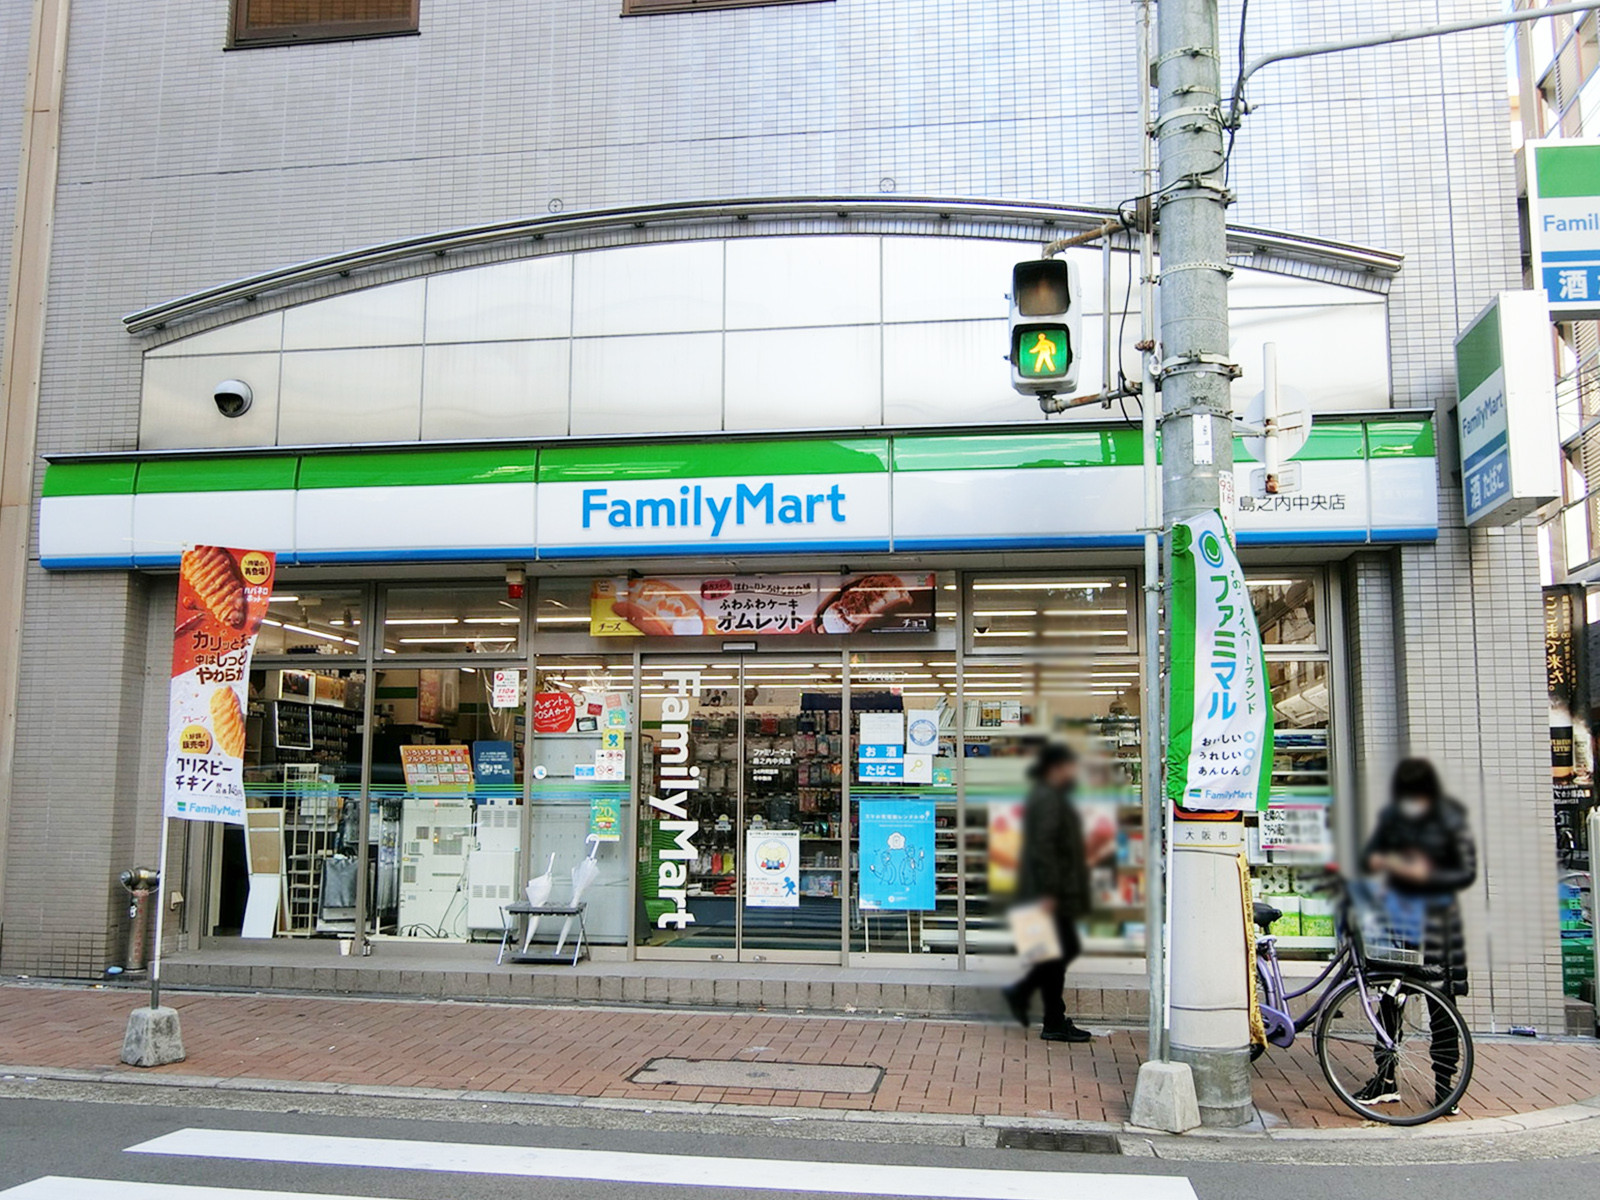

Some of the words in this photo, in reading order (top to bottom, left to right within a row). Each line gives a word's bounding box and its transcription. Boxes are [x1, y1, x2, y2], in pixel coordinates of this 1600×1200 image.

[1559, 270, 1588, 299] 酒
[1462, 390, 1503, 438] FamilyMart
[1470, 473, 1482, 509] 酒
[1483, 463, 1505, 499] たばこ
[582, 483, 845, 537] FamilyMart
[1239, 494, 1346, 512] 島之内中央店
[720, 598, 799, 610] ふわふわケーキ
[599, 622, 621, 631] チーズ
[717, 611, 804, 631] オムレット
[902, 618, 927, 628] チョコ
[1207, 575, 1237, 720] ファミマル
[865, 746, 897, 757] お酒
[177, 758, 233, 776] クリスピー
[865, 764, 896, 776] たばこ
[1198, 766, 1240, 776] あんしん
[175, 775, 214, 792] チキン
[649, 671, 701, 929] FamilyMart
[1205, 789, 1253, 800] FamilyMart
[189, 803, 242, 817] FamilyMart
[1186, 831, 1228, 841] 大阪市
